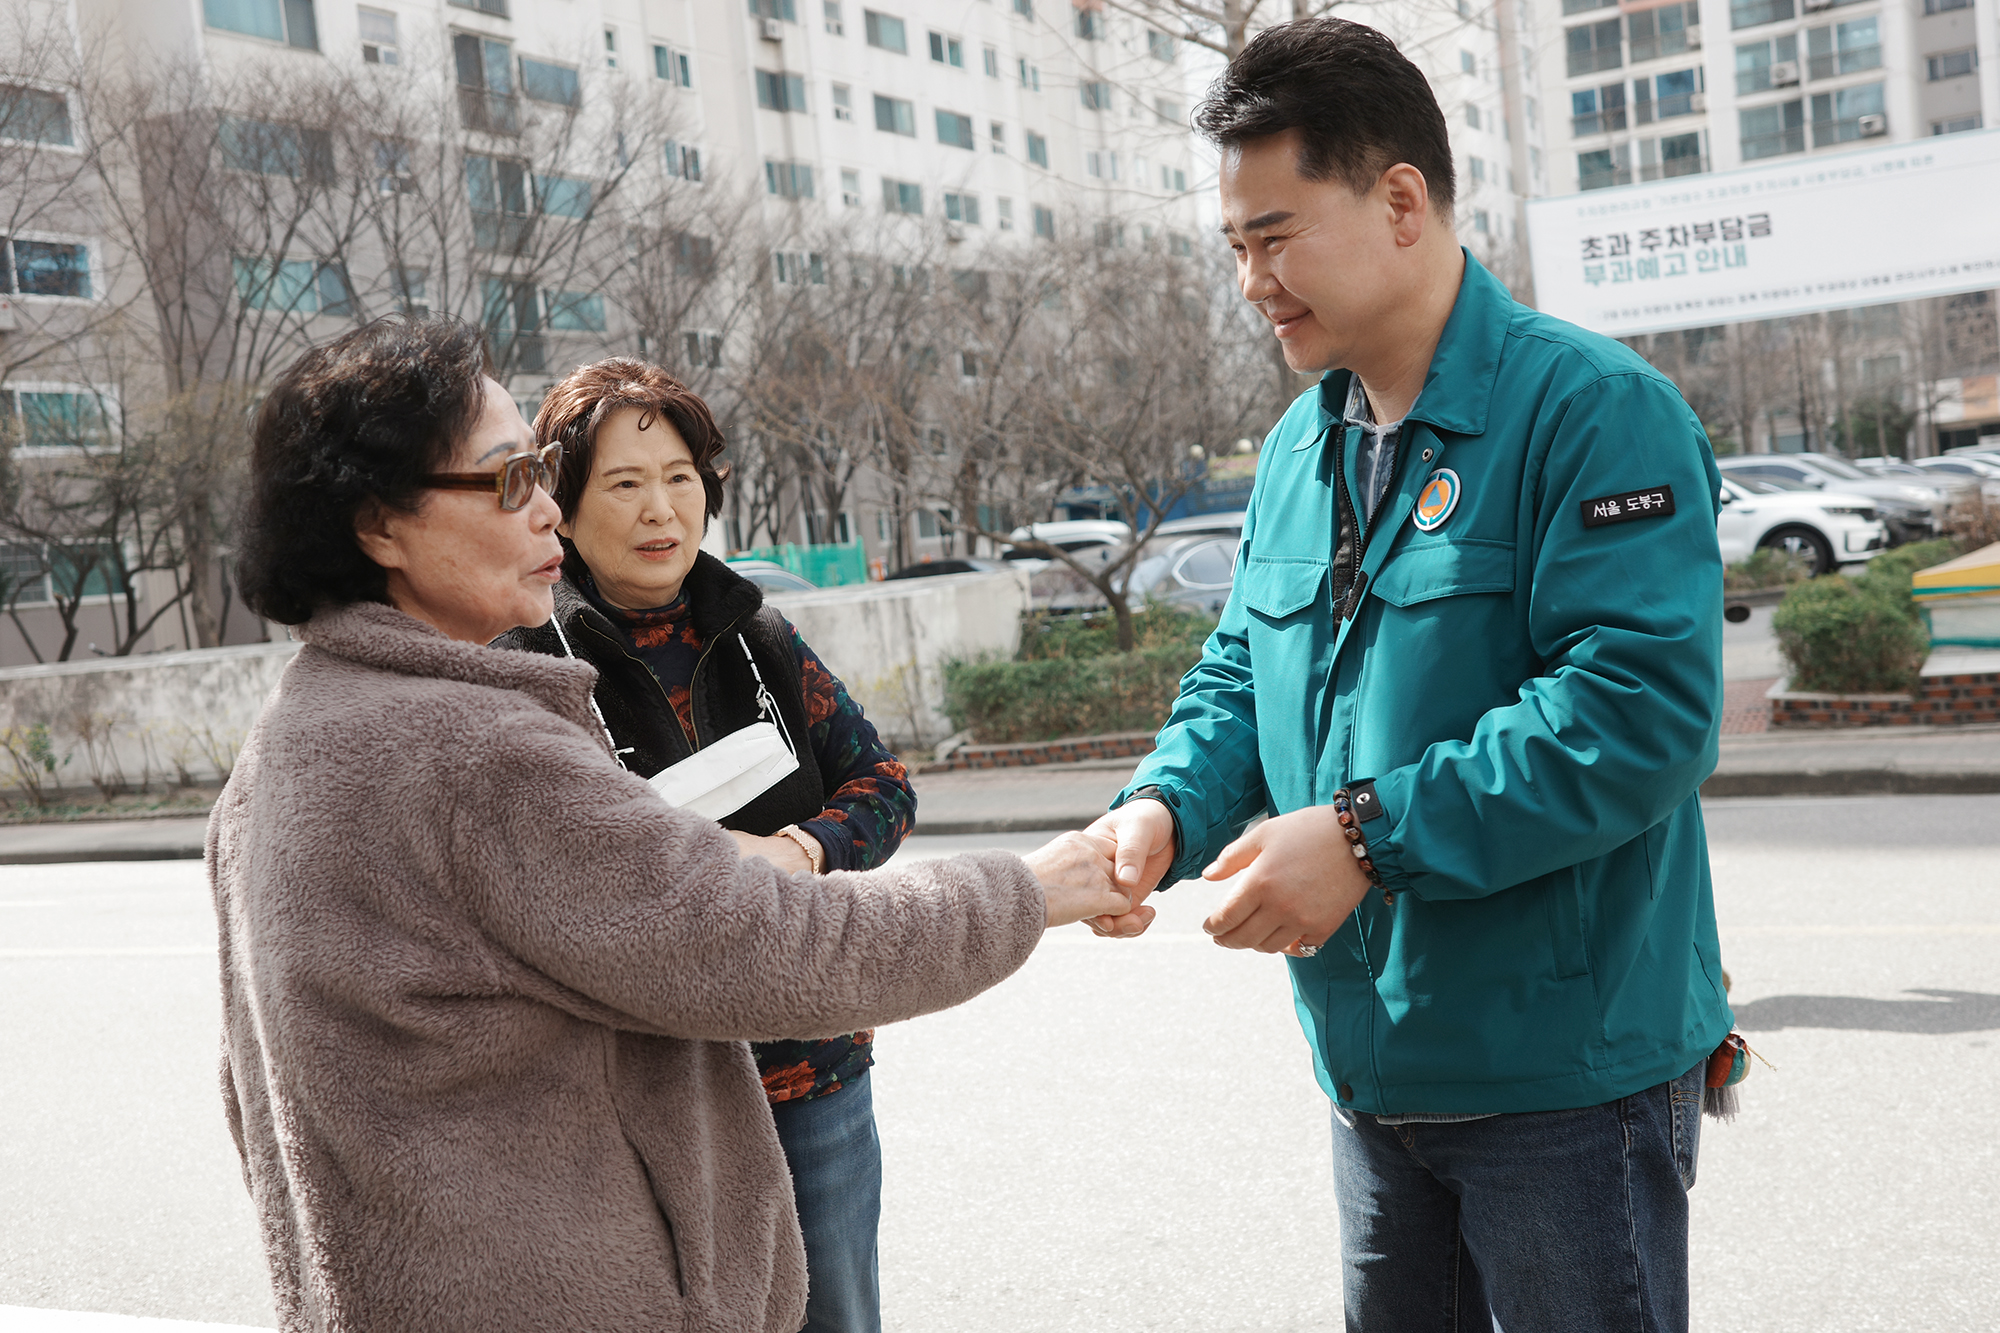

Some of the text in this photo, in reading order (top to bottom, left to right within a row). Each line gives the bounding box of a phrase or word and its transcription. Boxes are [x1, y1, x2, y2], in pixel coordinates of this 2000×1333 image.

[1580, 211, 1773, 261] 초과 주차부담금
[1583, 243, 1748, 287] 부과예고 안내
[1593, 493, 1665, 518] 서울 도봉구
